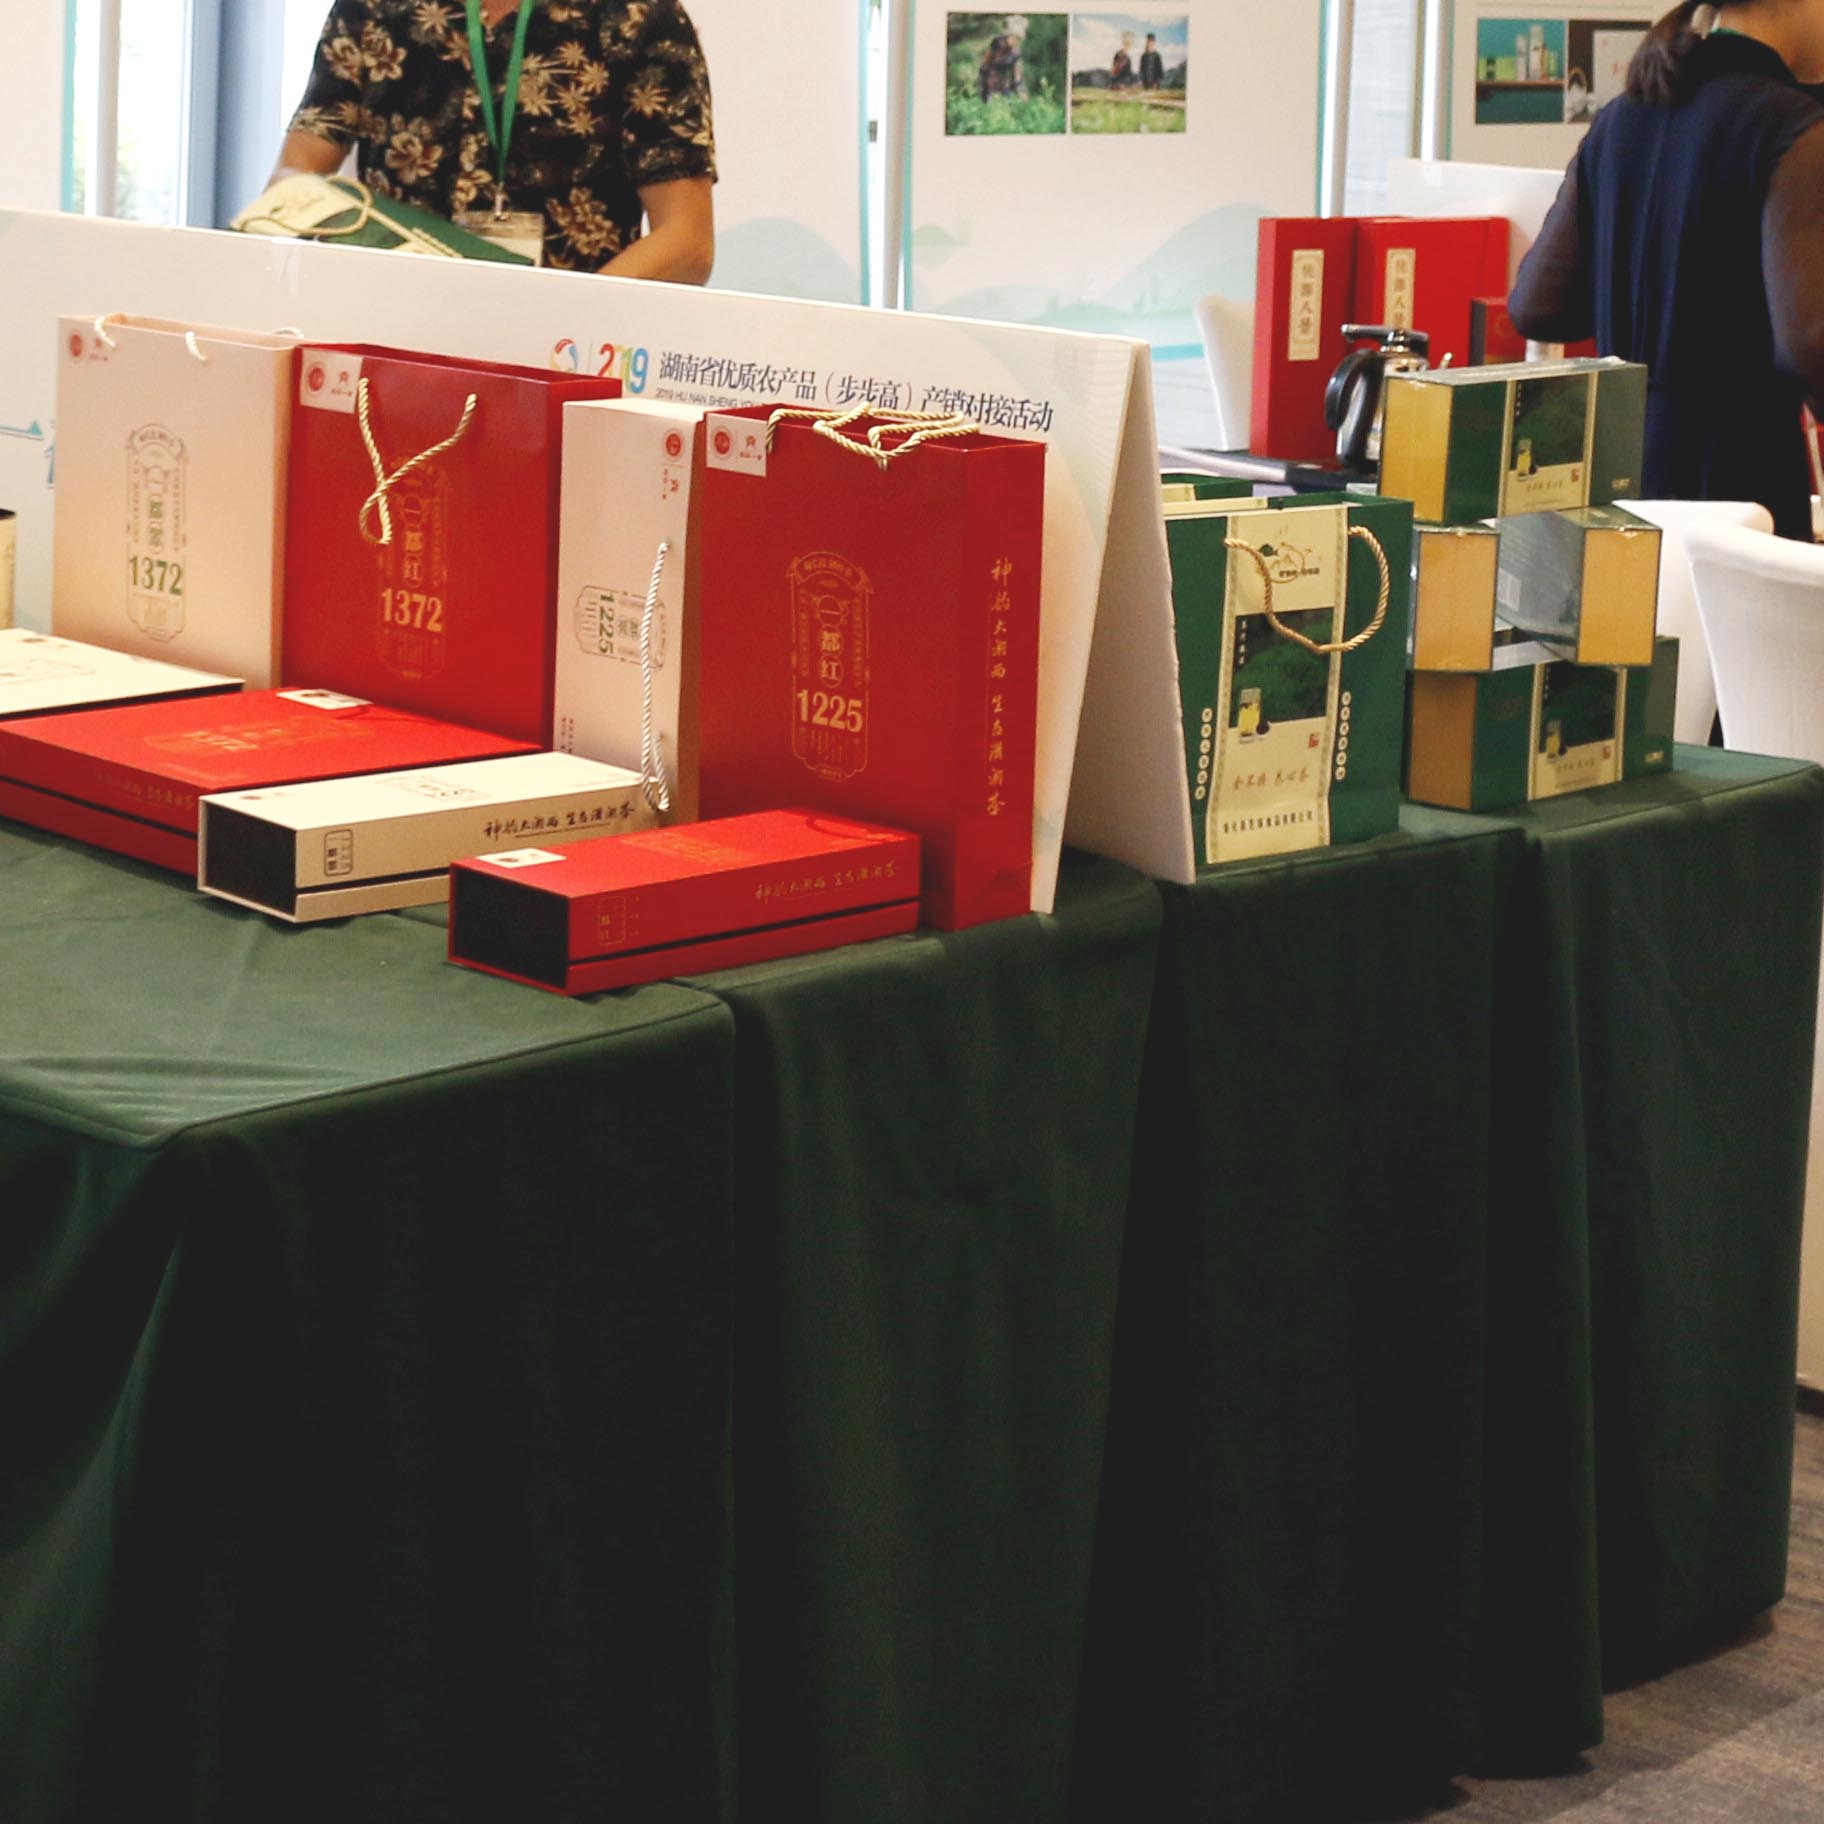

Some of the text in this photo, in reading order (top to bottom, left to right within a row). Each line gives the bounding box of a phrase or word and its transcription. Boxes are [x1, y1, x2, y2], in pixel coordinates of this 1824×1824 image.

[659, 351, 1054, 434] 湖南省优质农产品（步步高）产销对接活动
[128, 555, 185, 596] 1372
[379, 587, 445, 633] 1372
[597, 592, 615, 655] 1225
[817, 600, 845, 687] 一都红
[795, 687, 864, 734] 1225
